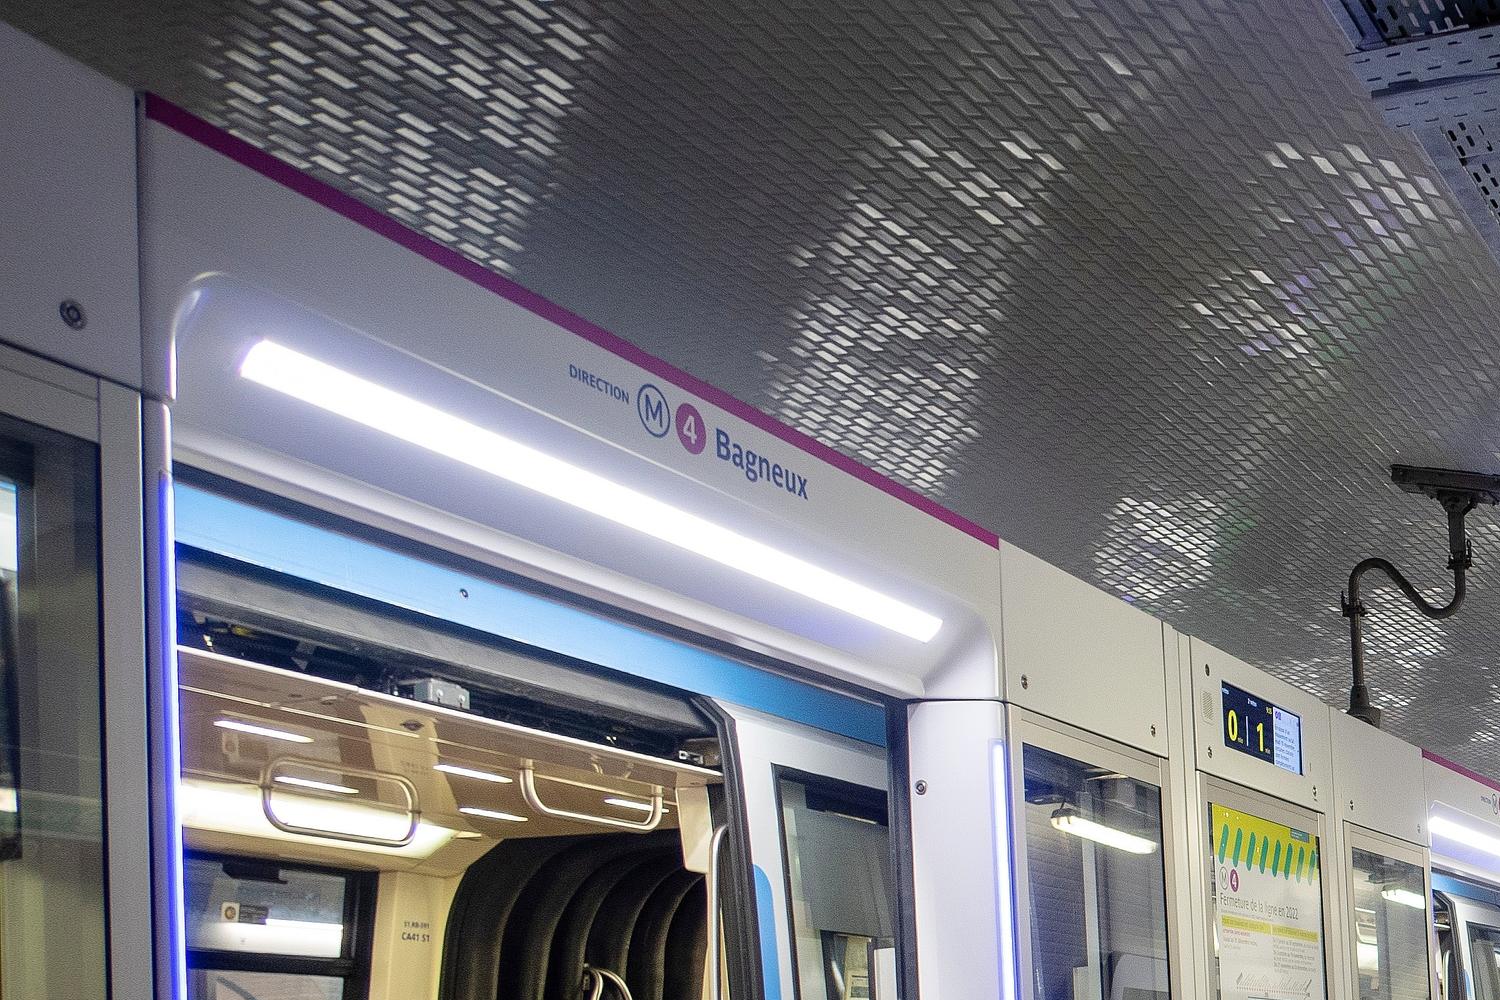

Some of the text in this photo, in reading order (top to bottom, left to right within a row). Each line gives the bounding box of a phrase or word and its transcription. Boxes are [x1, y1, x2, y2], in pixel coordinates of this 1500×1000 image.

[569, 363, 630, 405] DIRECTION
[683, 414, 697, 445] 4
[716, 427, 810, 501] Bagneux
[1227, 709, 1238, 742] 0
[1256, 722, 1264, 752] 1
[1219, 892, 1249, 911] Fermeture
